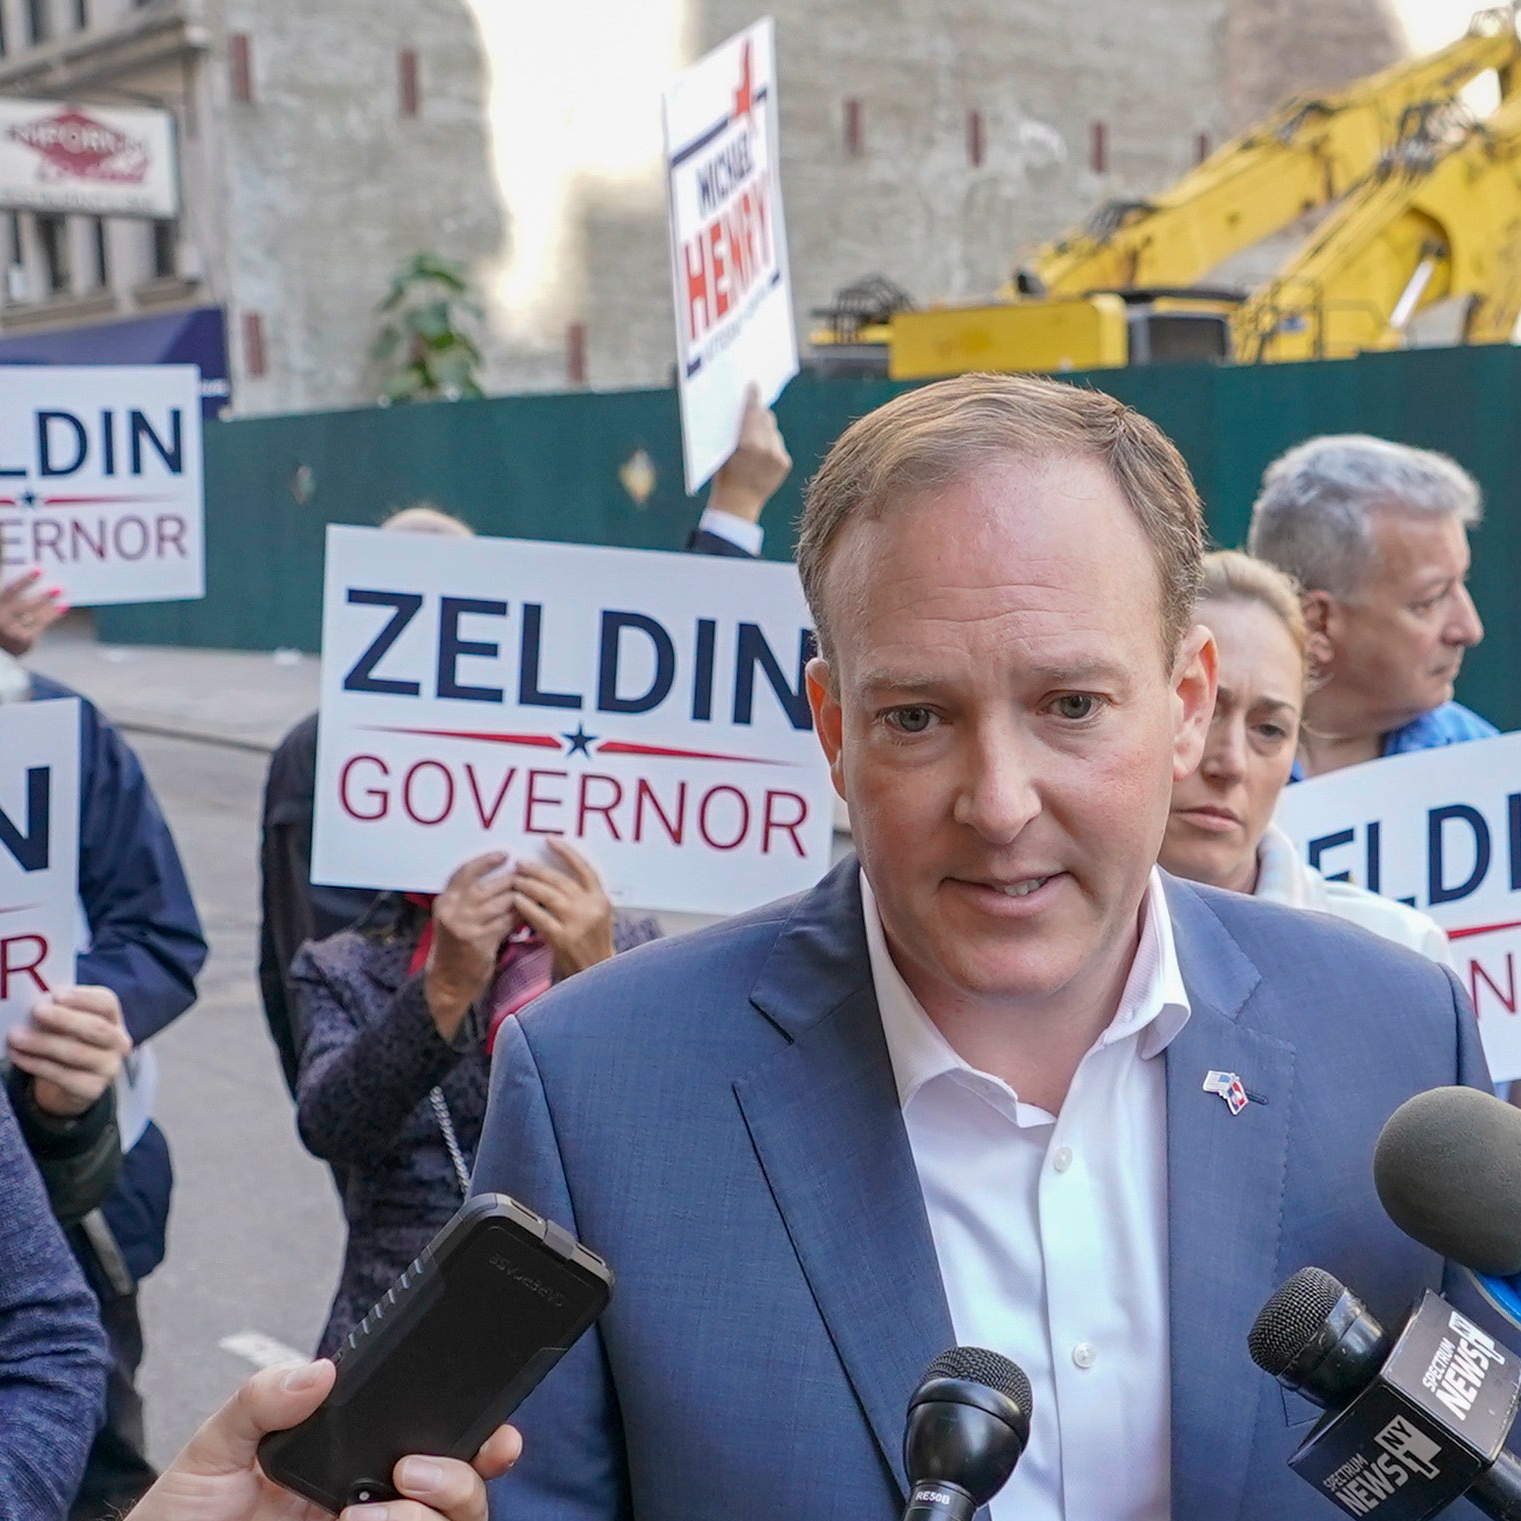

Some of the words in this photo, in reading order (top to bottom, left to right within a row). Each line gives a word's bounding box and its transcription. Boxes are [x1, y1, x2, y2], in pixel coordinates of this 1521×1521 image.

[682, 177, 773, 341] HENRY
[342, 587, 815, 732] ZELDIN
[339, 753, 808, 858] GOVERNOR
[1422, 1337, 1457, 1393] SPECTRUM
[1435, 1338, 1490, 1421] NEWS
[1380, 1419, 1413, 1451] NY
[915, 1491, 951, 1505] RE50B
[1323, 1453, 1370, 1492] SPECTRUM
[1335, 1453, 1409, 1517] NEWS
